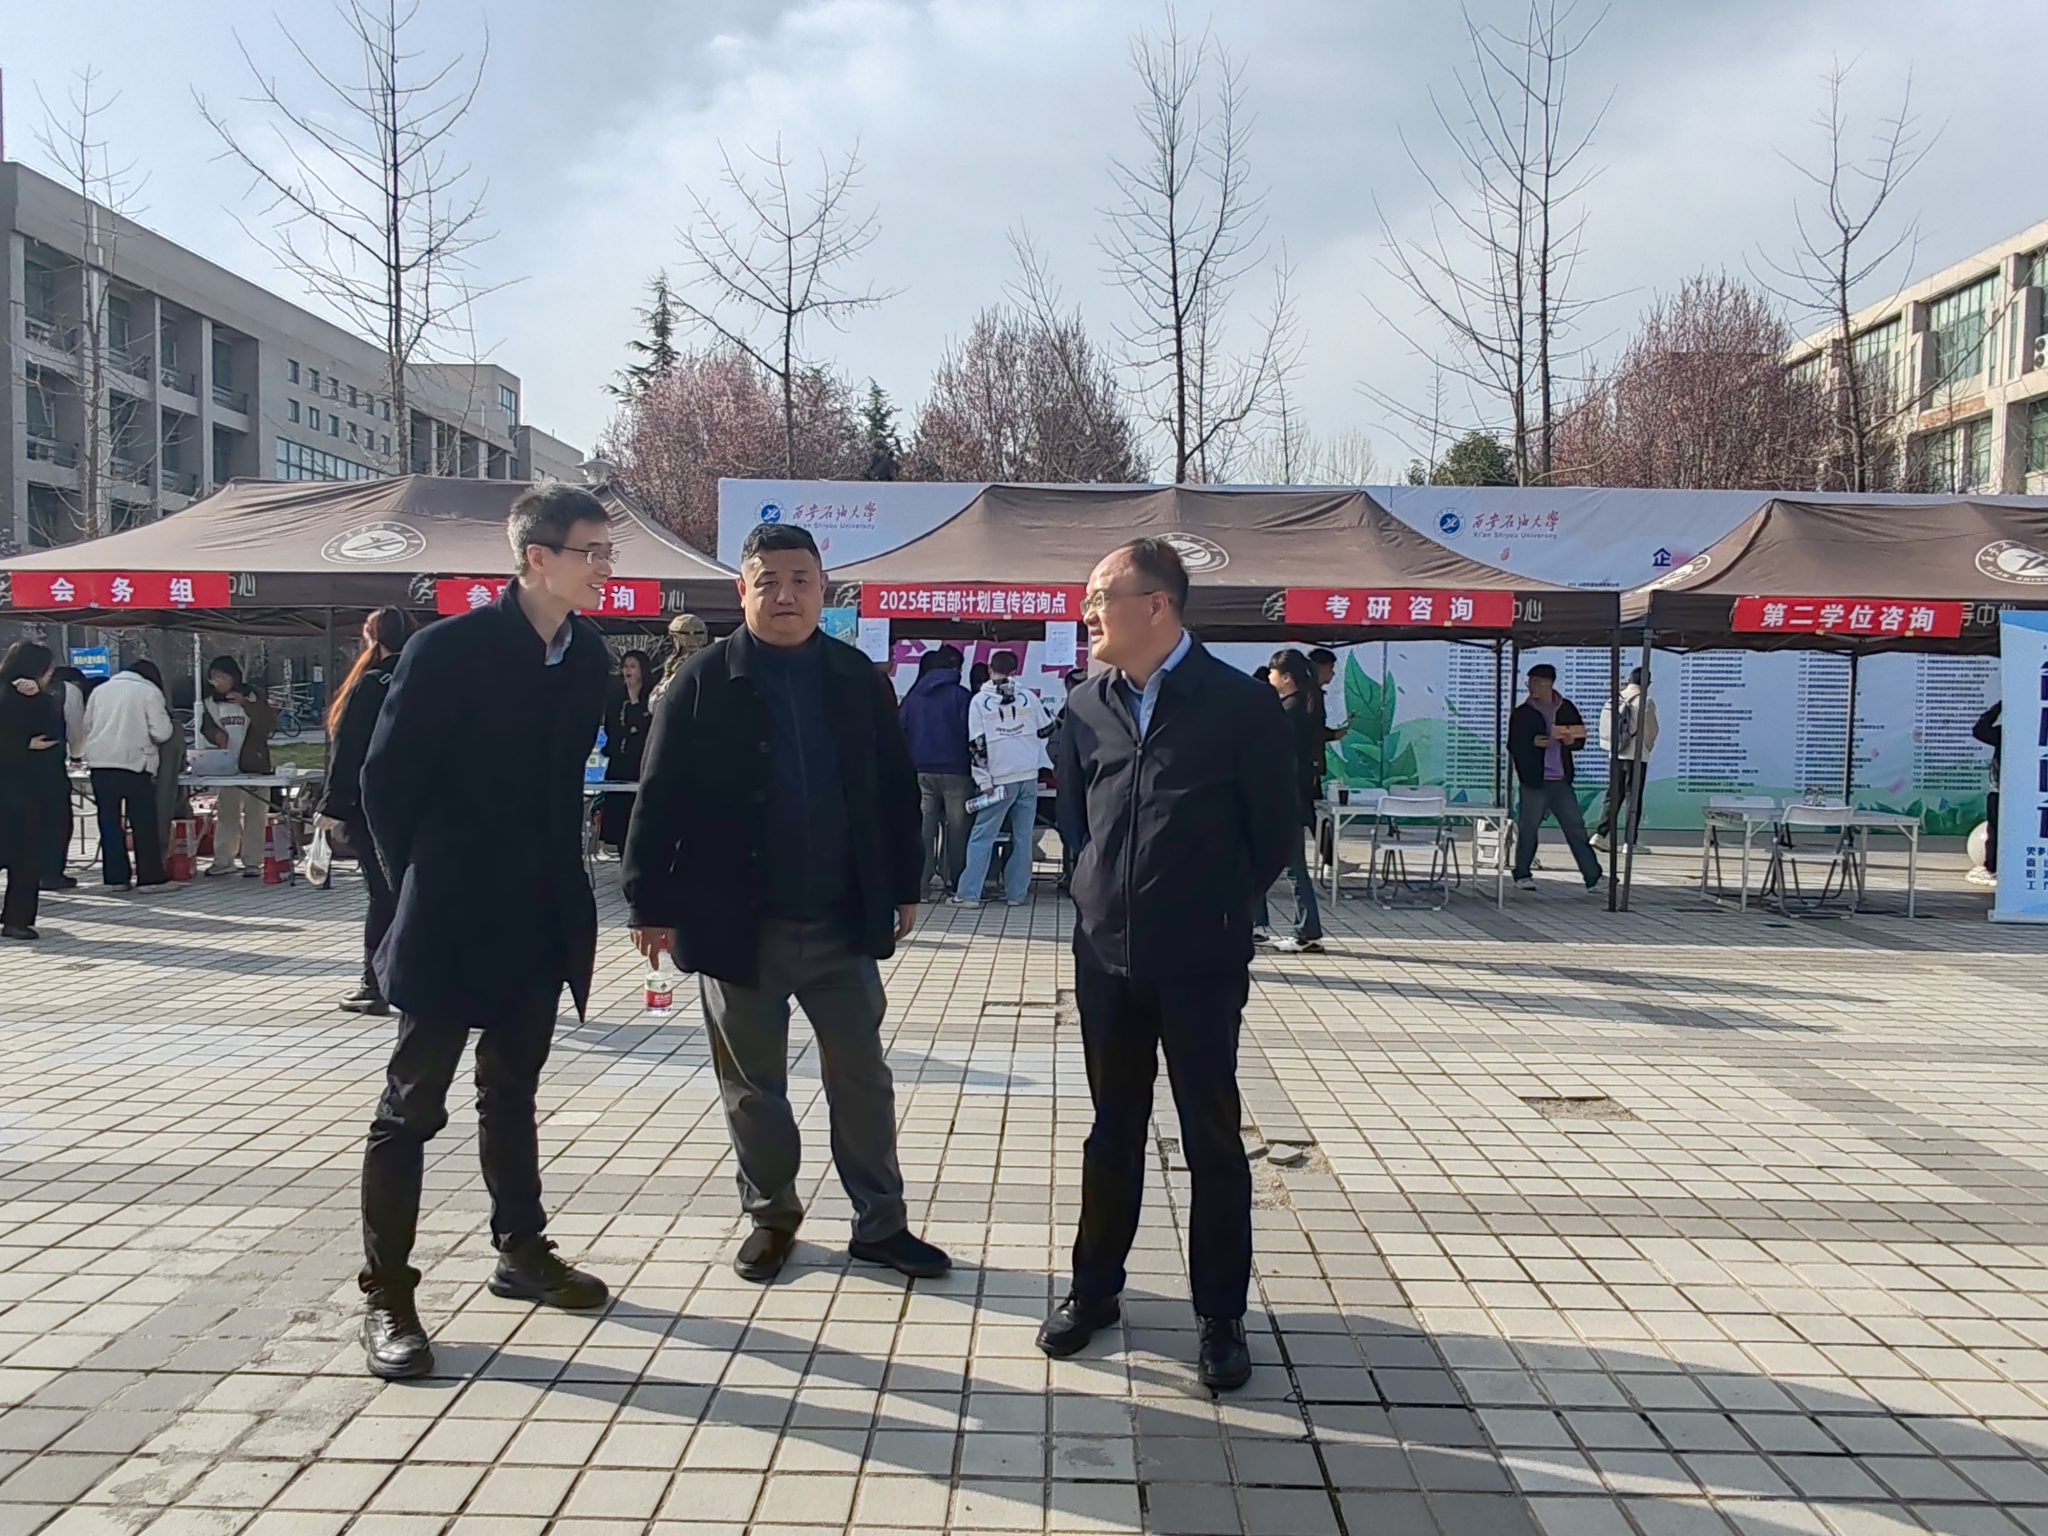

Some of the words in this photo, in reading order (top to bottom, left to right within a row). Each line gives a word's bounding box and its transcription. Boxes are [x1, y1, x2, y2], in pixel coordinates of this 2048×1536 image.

[840, 522, 876, 530] University
[1521, 532, 1558, 540] University
[1652, 547, 1672, 567] 企
[50, 577, 195, 602] 会务组
[879, 590, 1067, 614] 2025年西部计划宣传咨询点
[1325, 595, 1474, 621] 考研咨询
[1760, 603, 1936, 632] 第二学位咨询
